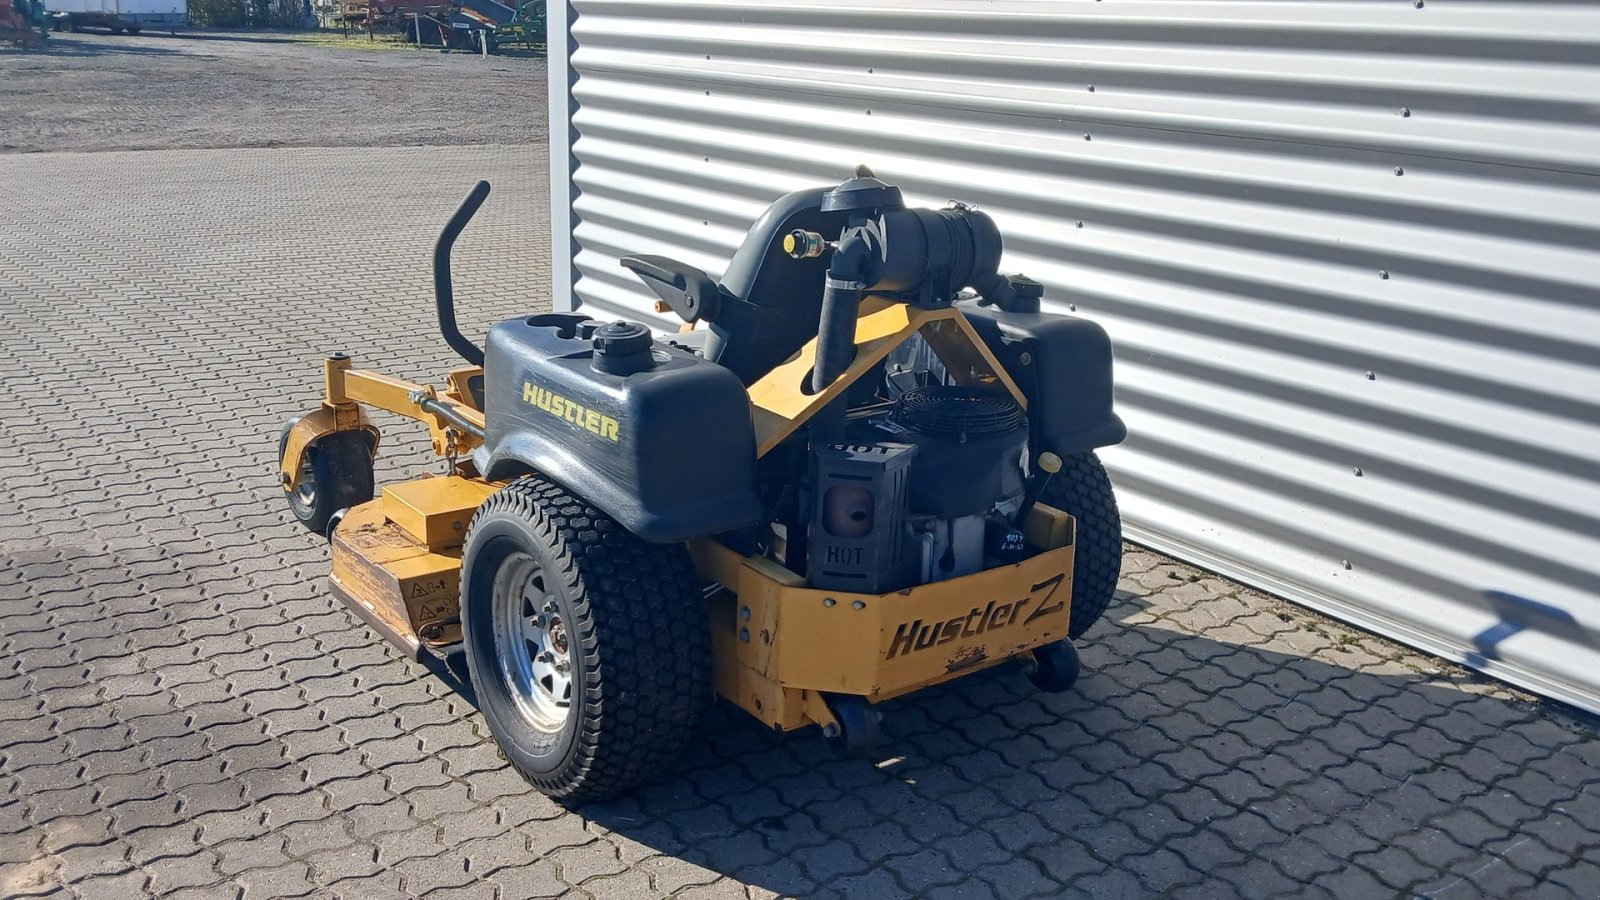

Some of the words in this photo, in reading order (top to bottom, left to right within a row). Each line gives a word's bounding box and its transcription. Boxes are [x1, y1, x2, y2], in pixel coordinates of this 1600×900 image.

[523, 381, 619, 441] HUSTLER
[827, 544, 864, 565] HOT
[885, 598, 1030, 660] Hustler
[1023, 573, 1066, 625] Z
